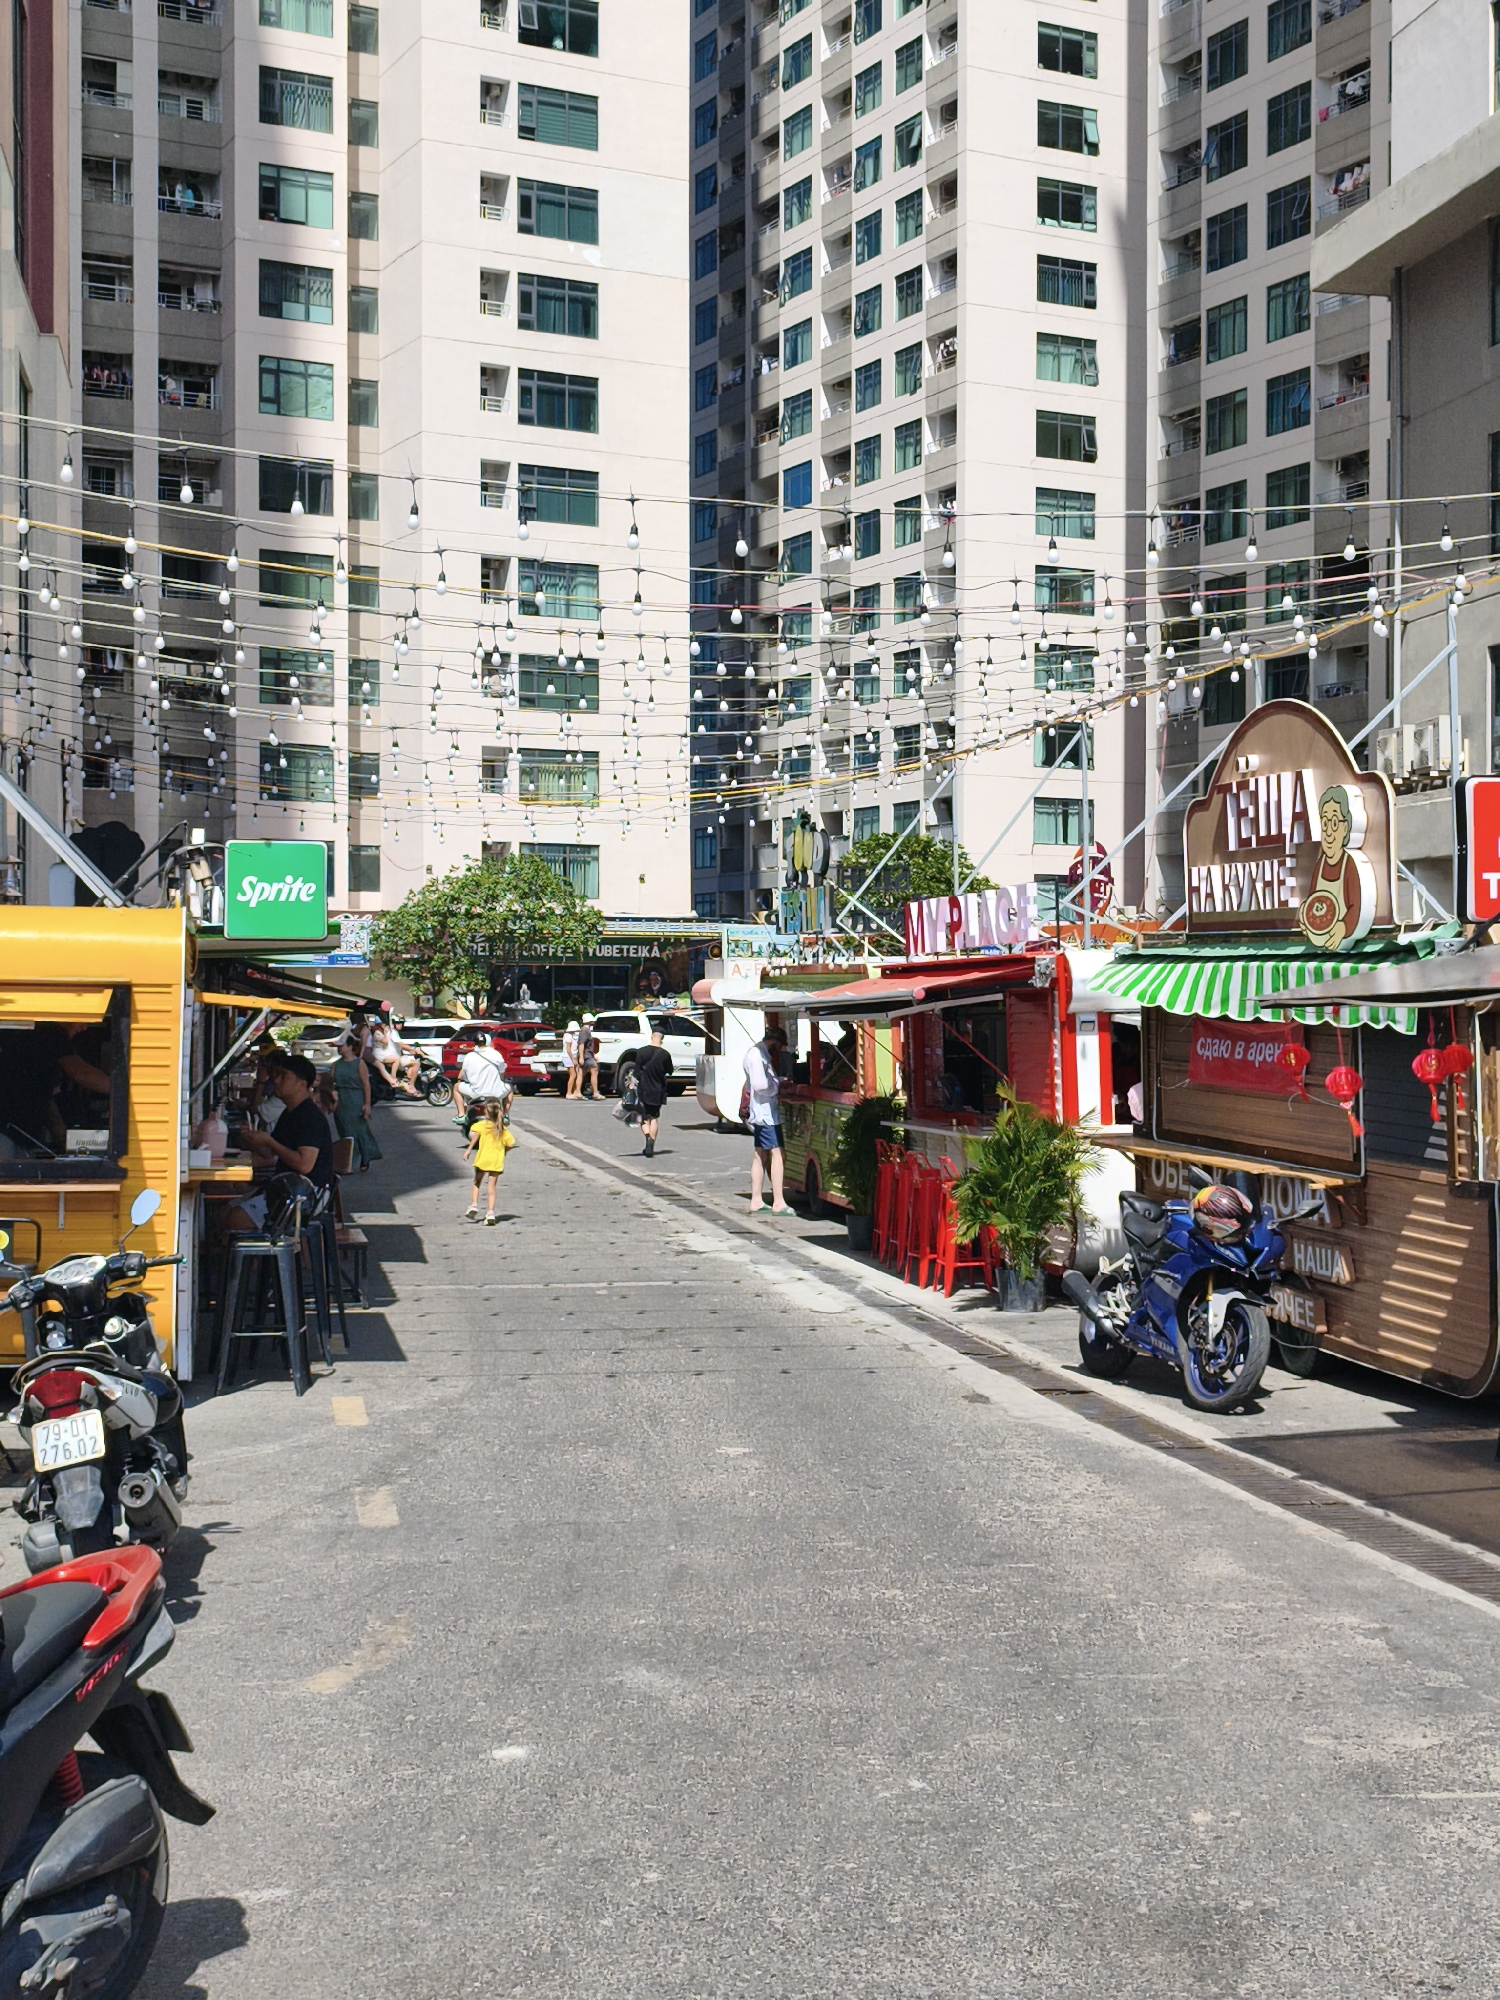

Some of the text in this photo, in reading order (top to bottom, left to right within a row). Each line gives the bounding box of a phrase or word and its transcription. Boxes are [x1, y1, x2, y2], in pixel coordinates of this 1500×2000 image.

[1215, 754, 1319, 855] ТЁЩА
[236, 874, 317, 908] Sprite
[1189, 857, 1299, 912] НА КУХНЕ
[1482, 872, 1500, 899] T
[903, 897, 947, 955] MY
[948, 882, 1039, 949] PLACE
[1196, 1037, 1284, 1067] сдаю в арен
[1293, 1242, 1346, 1282] НАША
[1265, 1290, 1315, 1329] ЯЧЕЕ
[40, 1436, 98, 1467] 276.02
